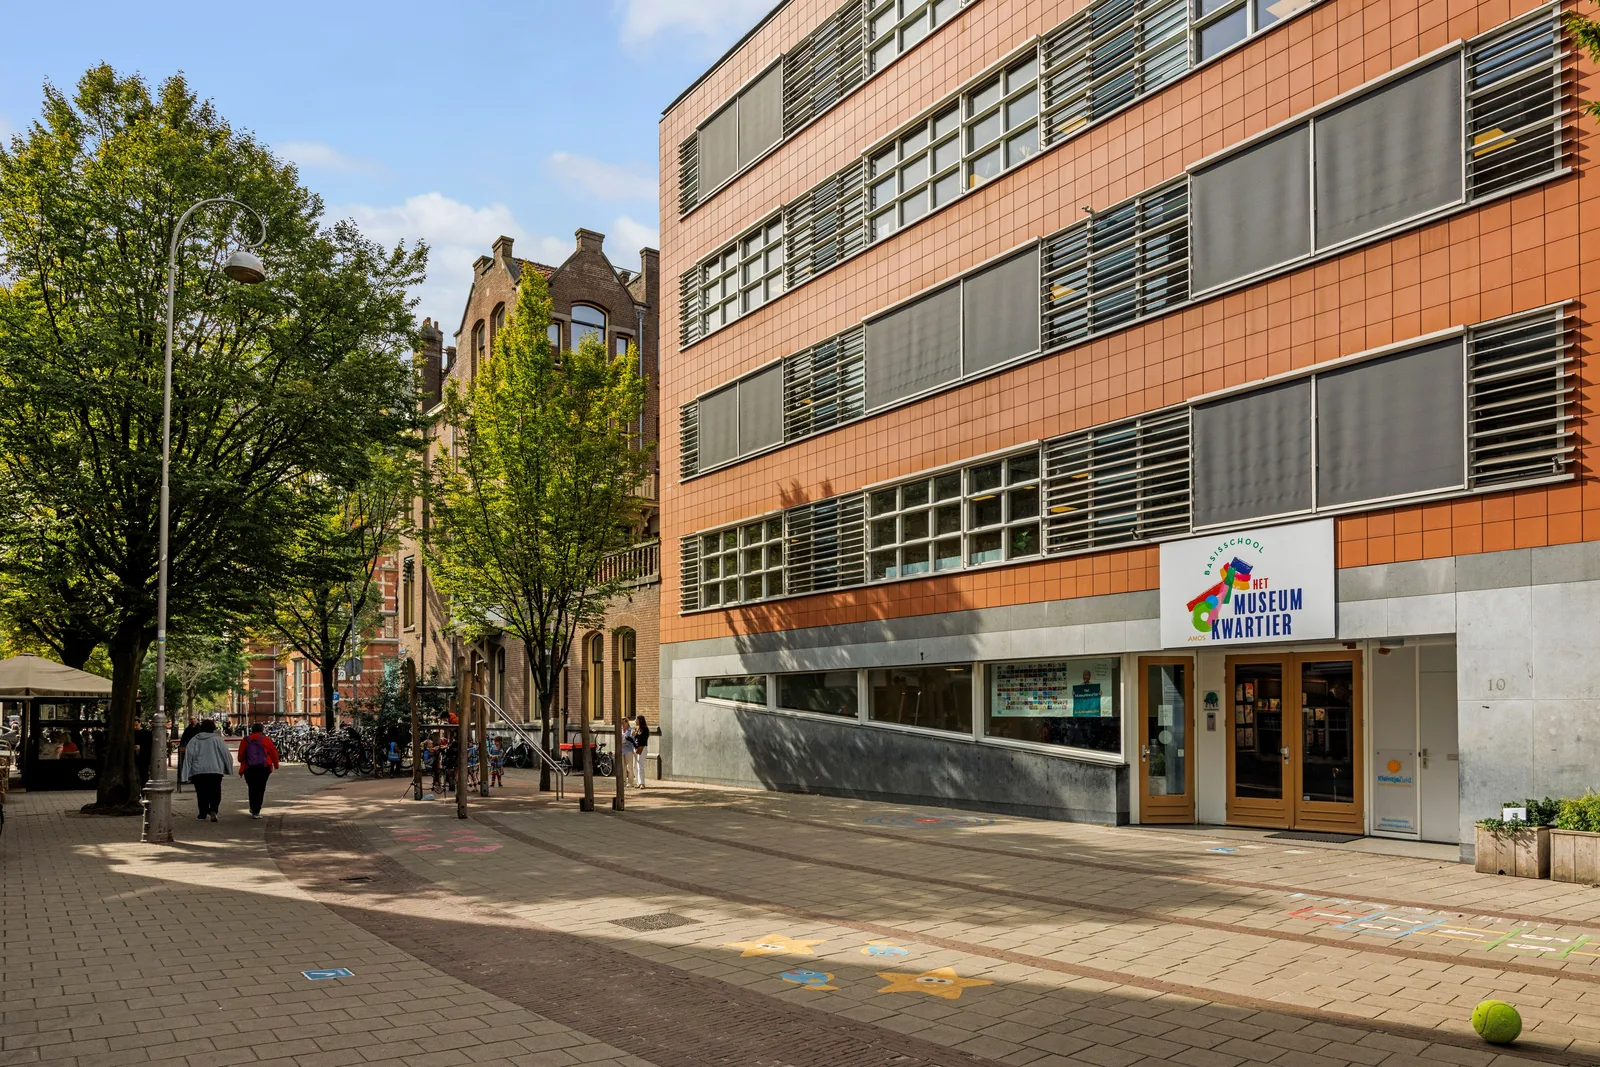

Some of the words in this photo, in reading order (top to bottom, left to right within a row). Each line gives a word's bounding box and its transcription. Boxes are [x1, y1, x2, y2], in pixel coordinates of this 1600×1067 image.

[1204, 538, 1264, 576] BASISSCHOOL
[1253, 578, 1269, 590] HET
[1234, 588, 1303, 615] MUSEUM
[1211, 613, 1292, 640] KWARTIER
[1488, 678, 1506, 691] 10
